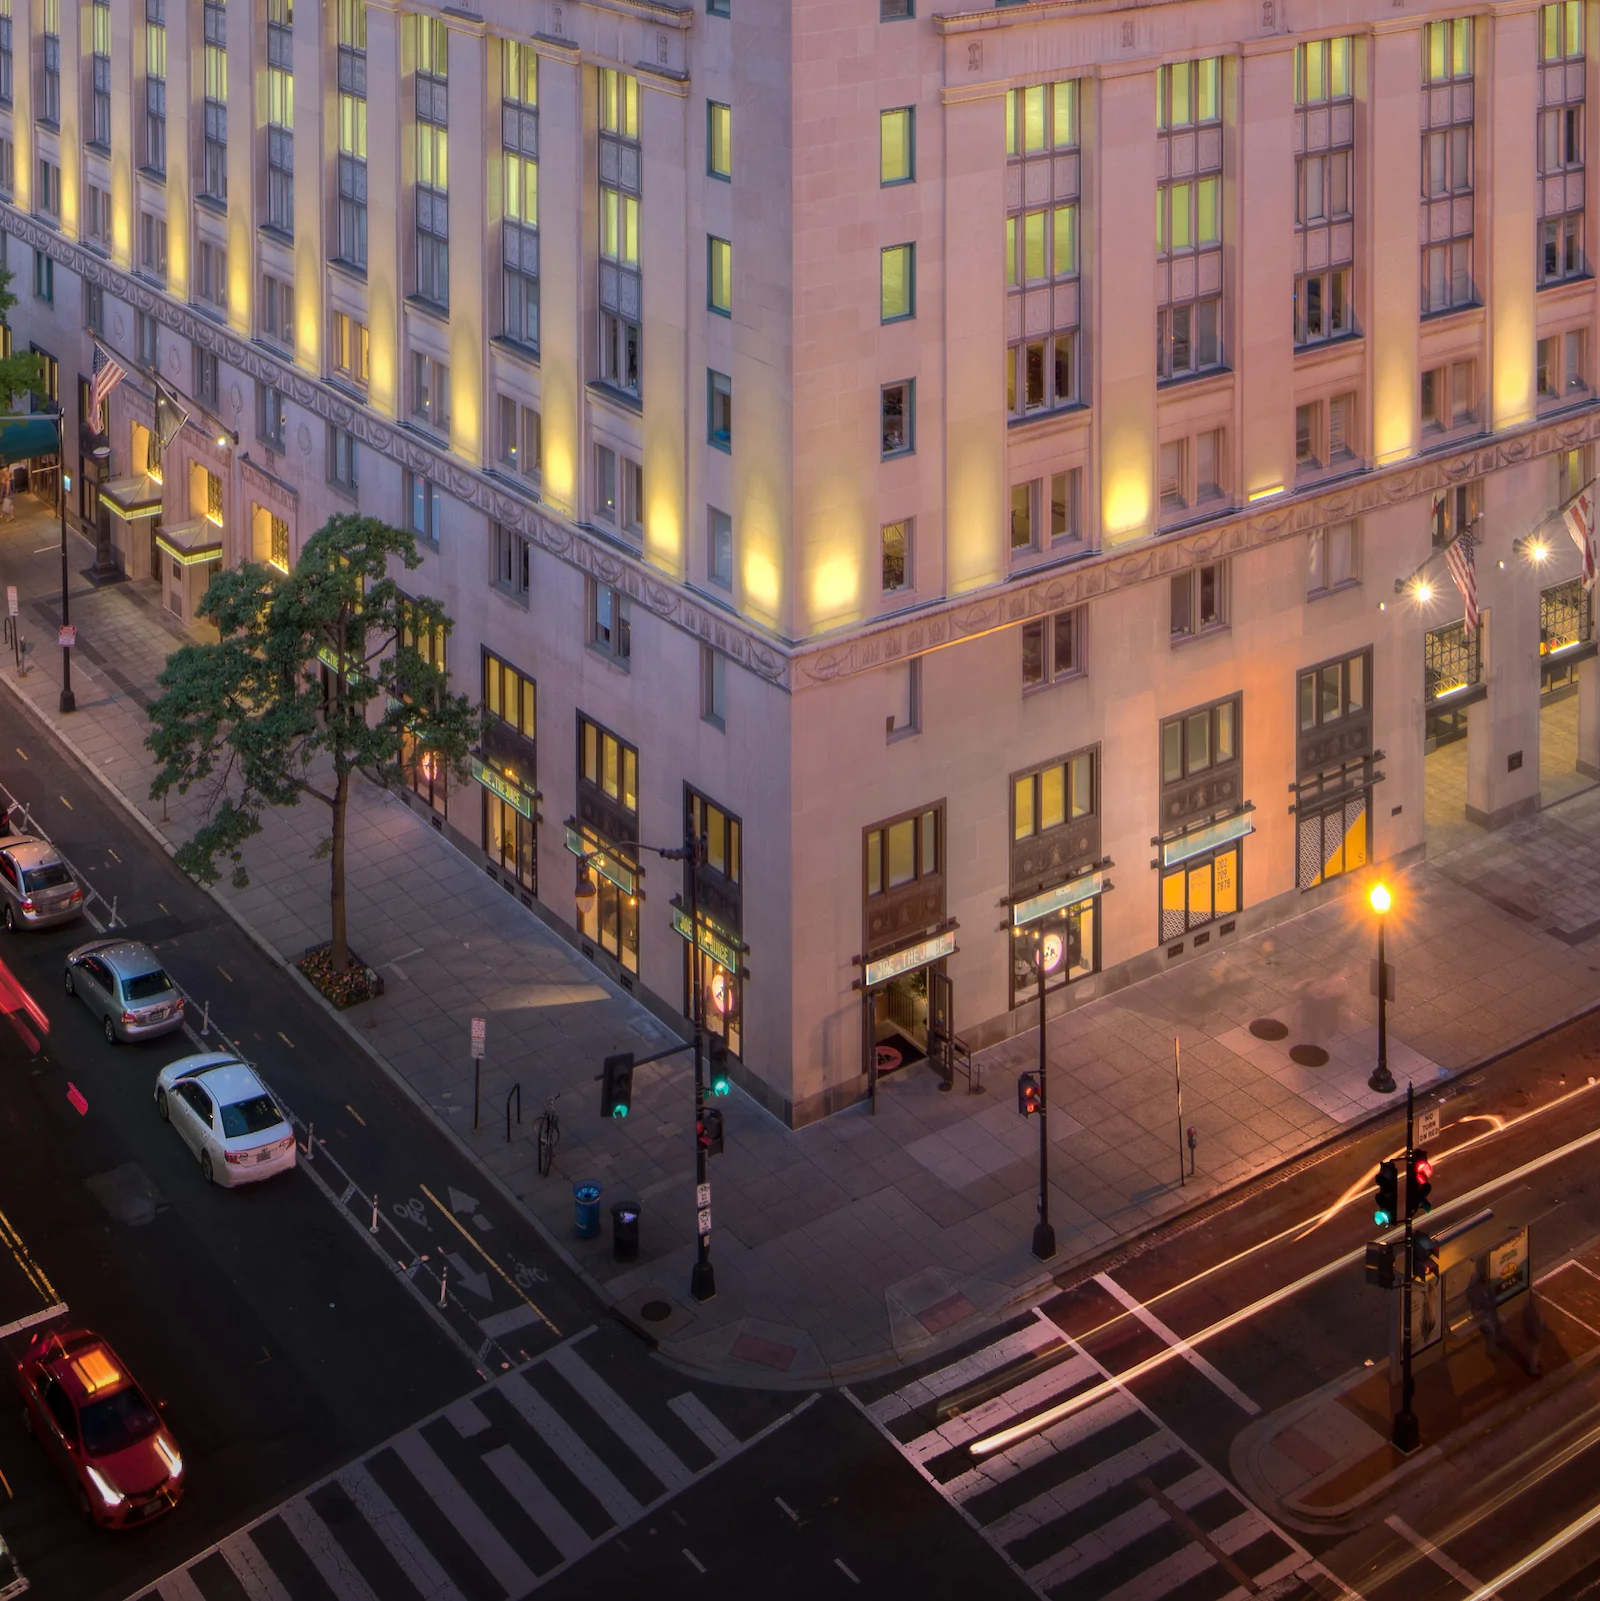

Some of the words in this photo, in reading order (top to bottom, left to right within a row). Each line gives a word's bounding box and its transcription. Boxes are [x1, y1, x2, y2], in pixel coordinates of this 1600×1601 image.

[481, 767, 492, 786] JOE
[505, 785, 520, 807] JUICE
[680, 915, 692, 936] JOE
[877, 958, 894, 978] JOE
[902, 948, 920, 968] THE
[920, 938, 945, 960] JCE
